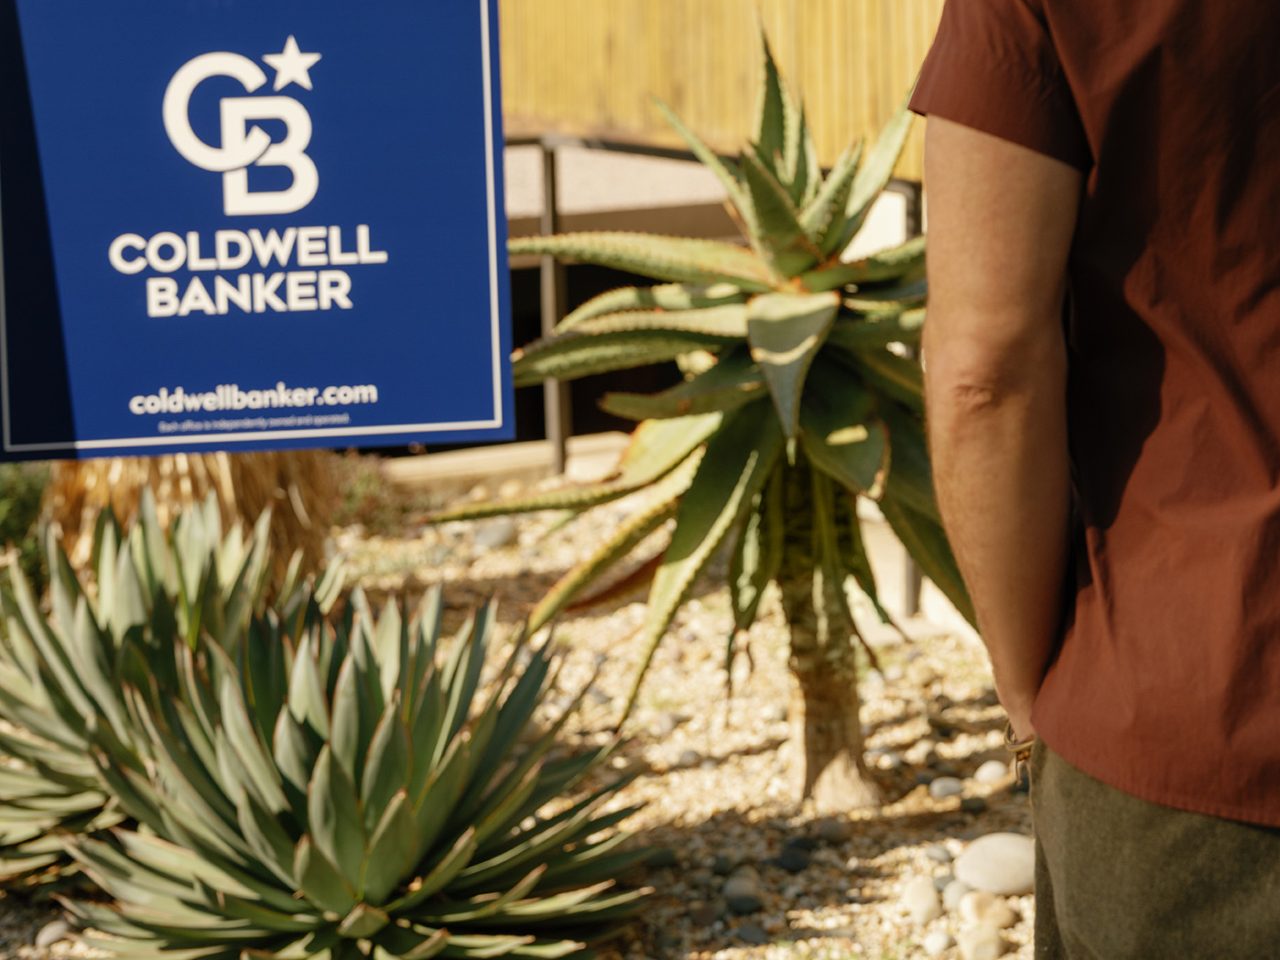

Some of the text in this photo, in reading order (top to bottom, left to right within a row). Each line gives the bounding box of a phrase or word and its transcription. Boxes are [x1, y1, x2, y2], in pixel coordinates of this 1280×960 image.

[108, 224, 389, 275] COLDWELL
[146, 269, 353, 318] BANKER
[129, 381, 378, 415] coldwellbanker.com
